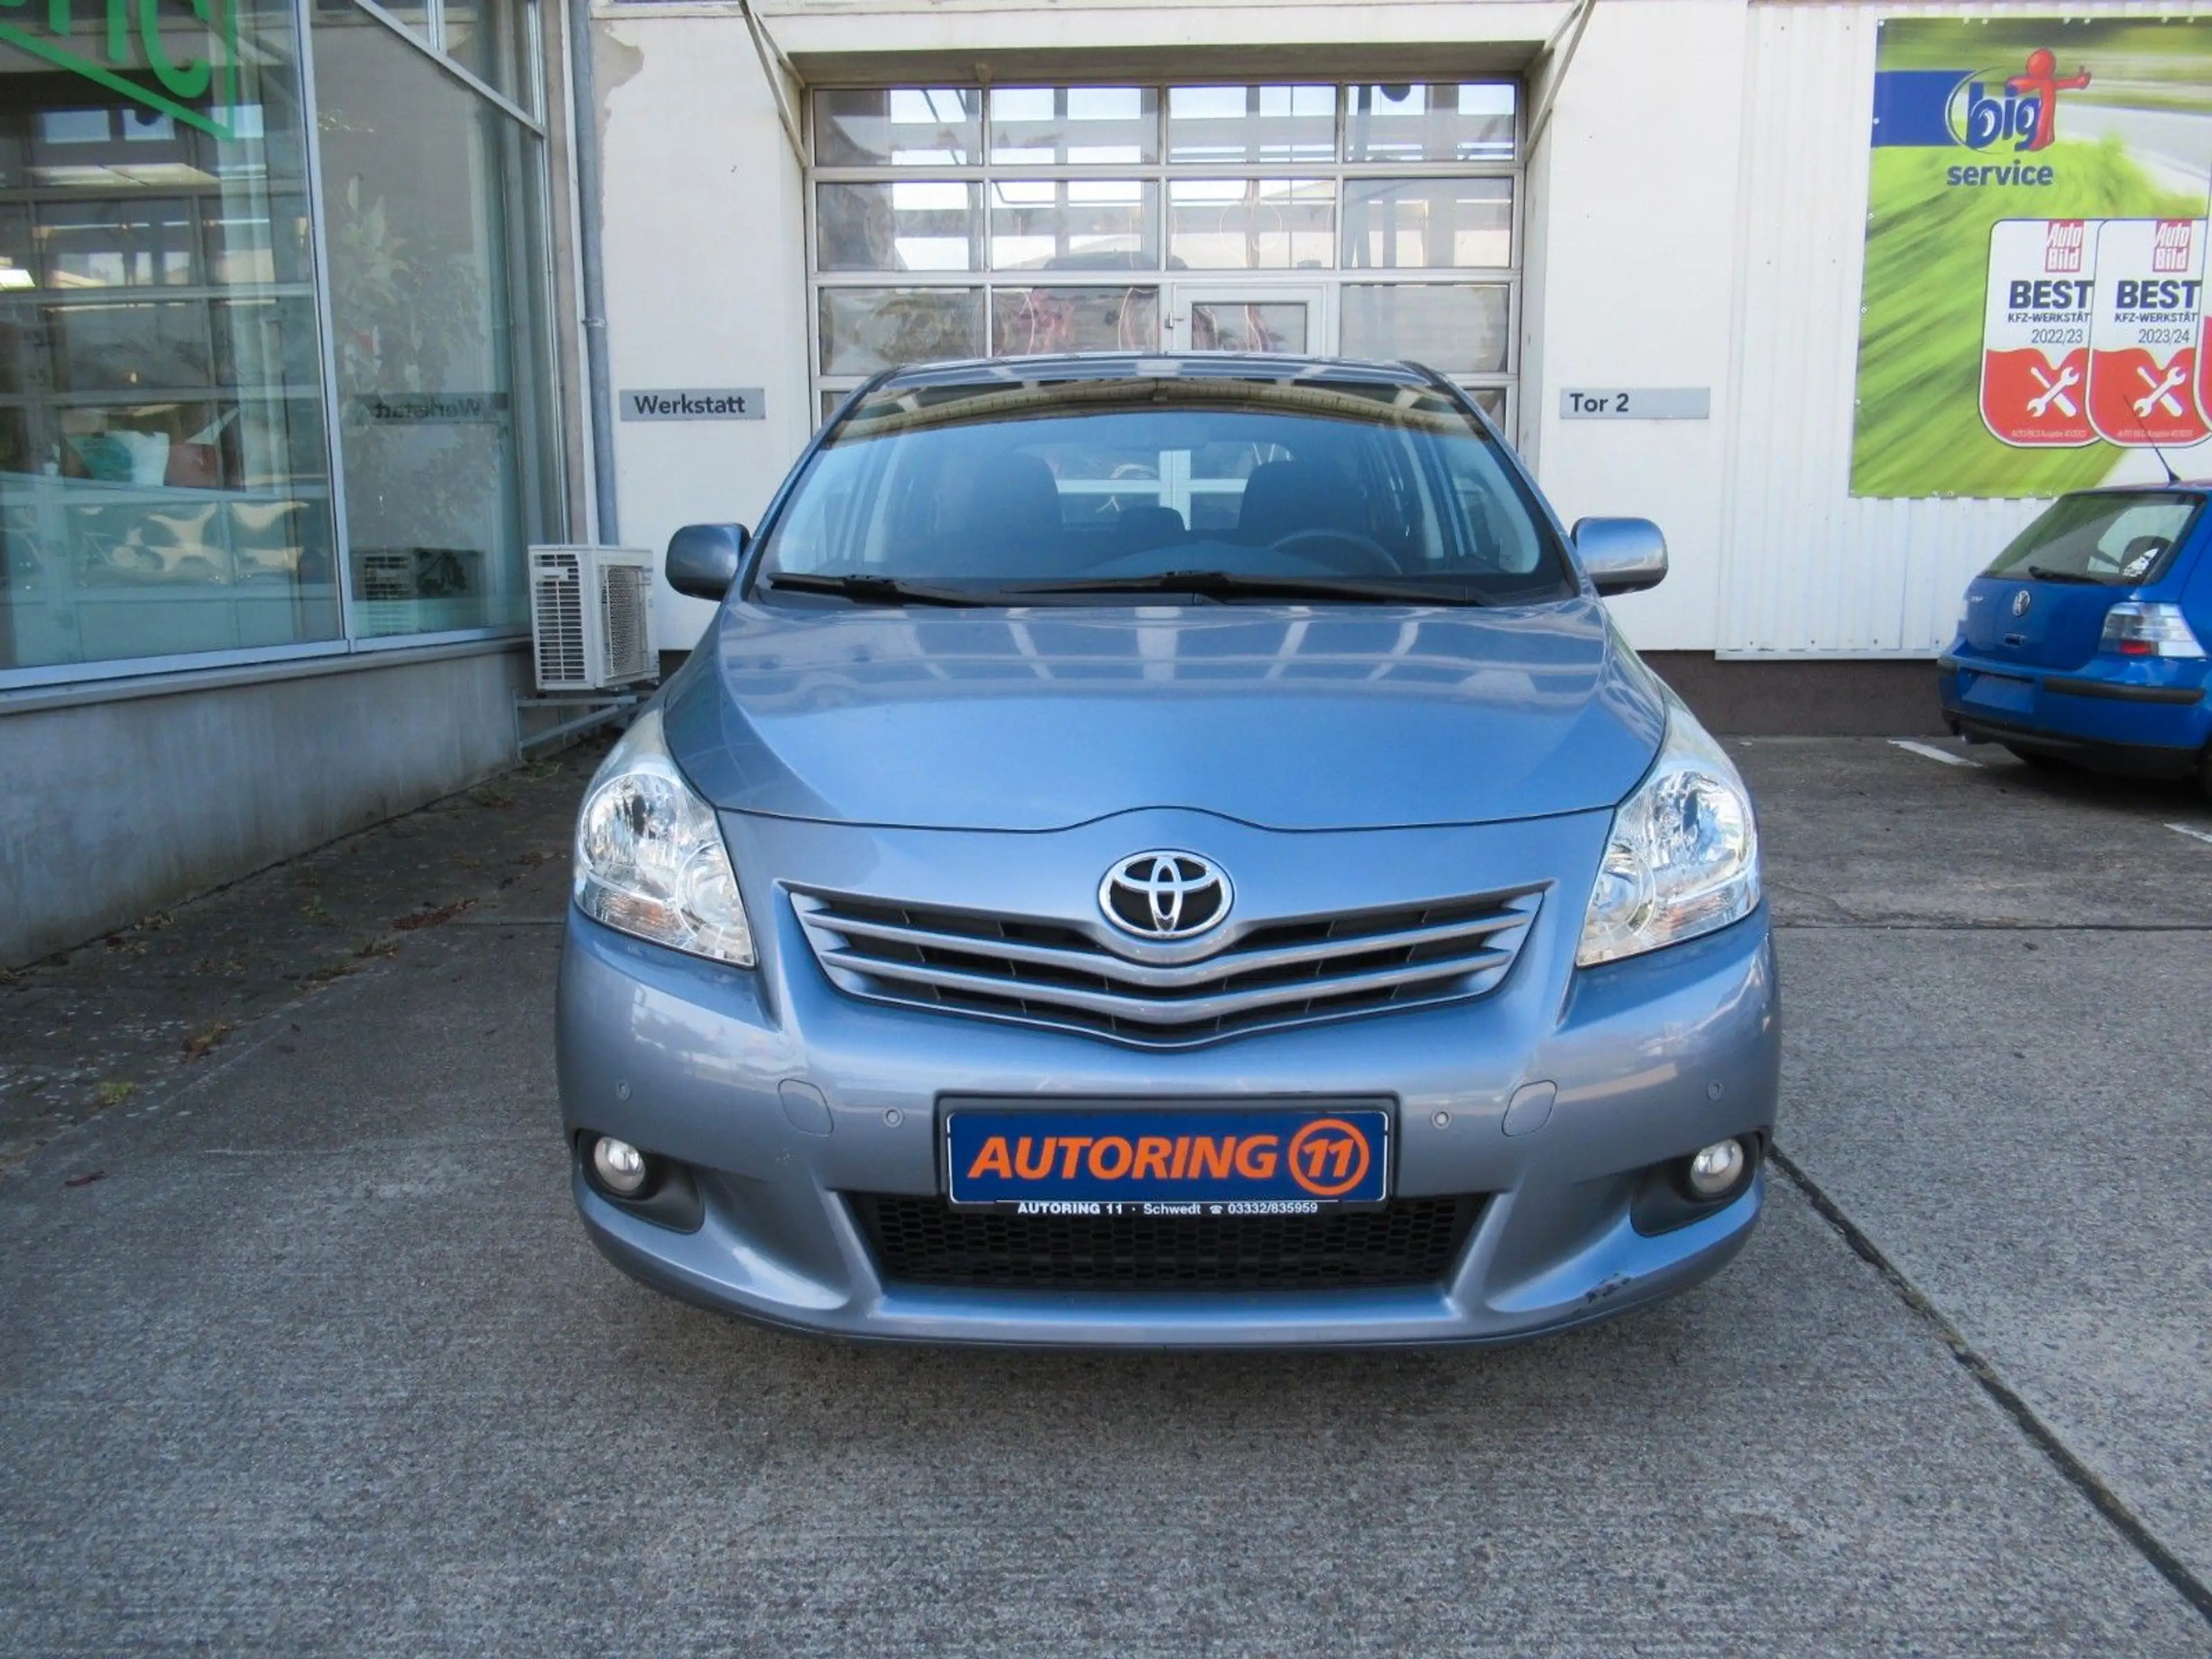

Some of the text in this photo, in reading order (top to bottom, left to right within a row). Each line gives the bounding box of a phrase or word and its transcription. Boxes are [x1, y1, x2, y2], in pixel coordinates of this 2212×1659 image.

[1946, 159, 2054, 185] service
[2047, 223, 2082, 247] Auto
[2156, 223, 2190, 247] Auto
[2047, 248, 2080, 270] Bild
[2154, 248, 2187, 270] Bild
[2009, 280, 2094, 309] BEST
[2116, 280, 2202, 309] BEST
[2031, 328, 2083, 344] 2022/23
[2138, 328, 2190, 344] 2023/24
[634, 394, 746, 414] Werkstatt
[1570, 393, 1629, 412] Tor 2
[967, 1135, 1354, 1180] AUTORING 11
[1017, 1202, 1318, 1214] AUTORING 11 Schwedt 03332/835959
